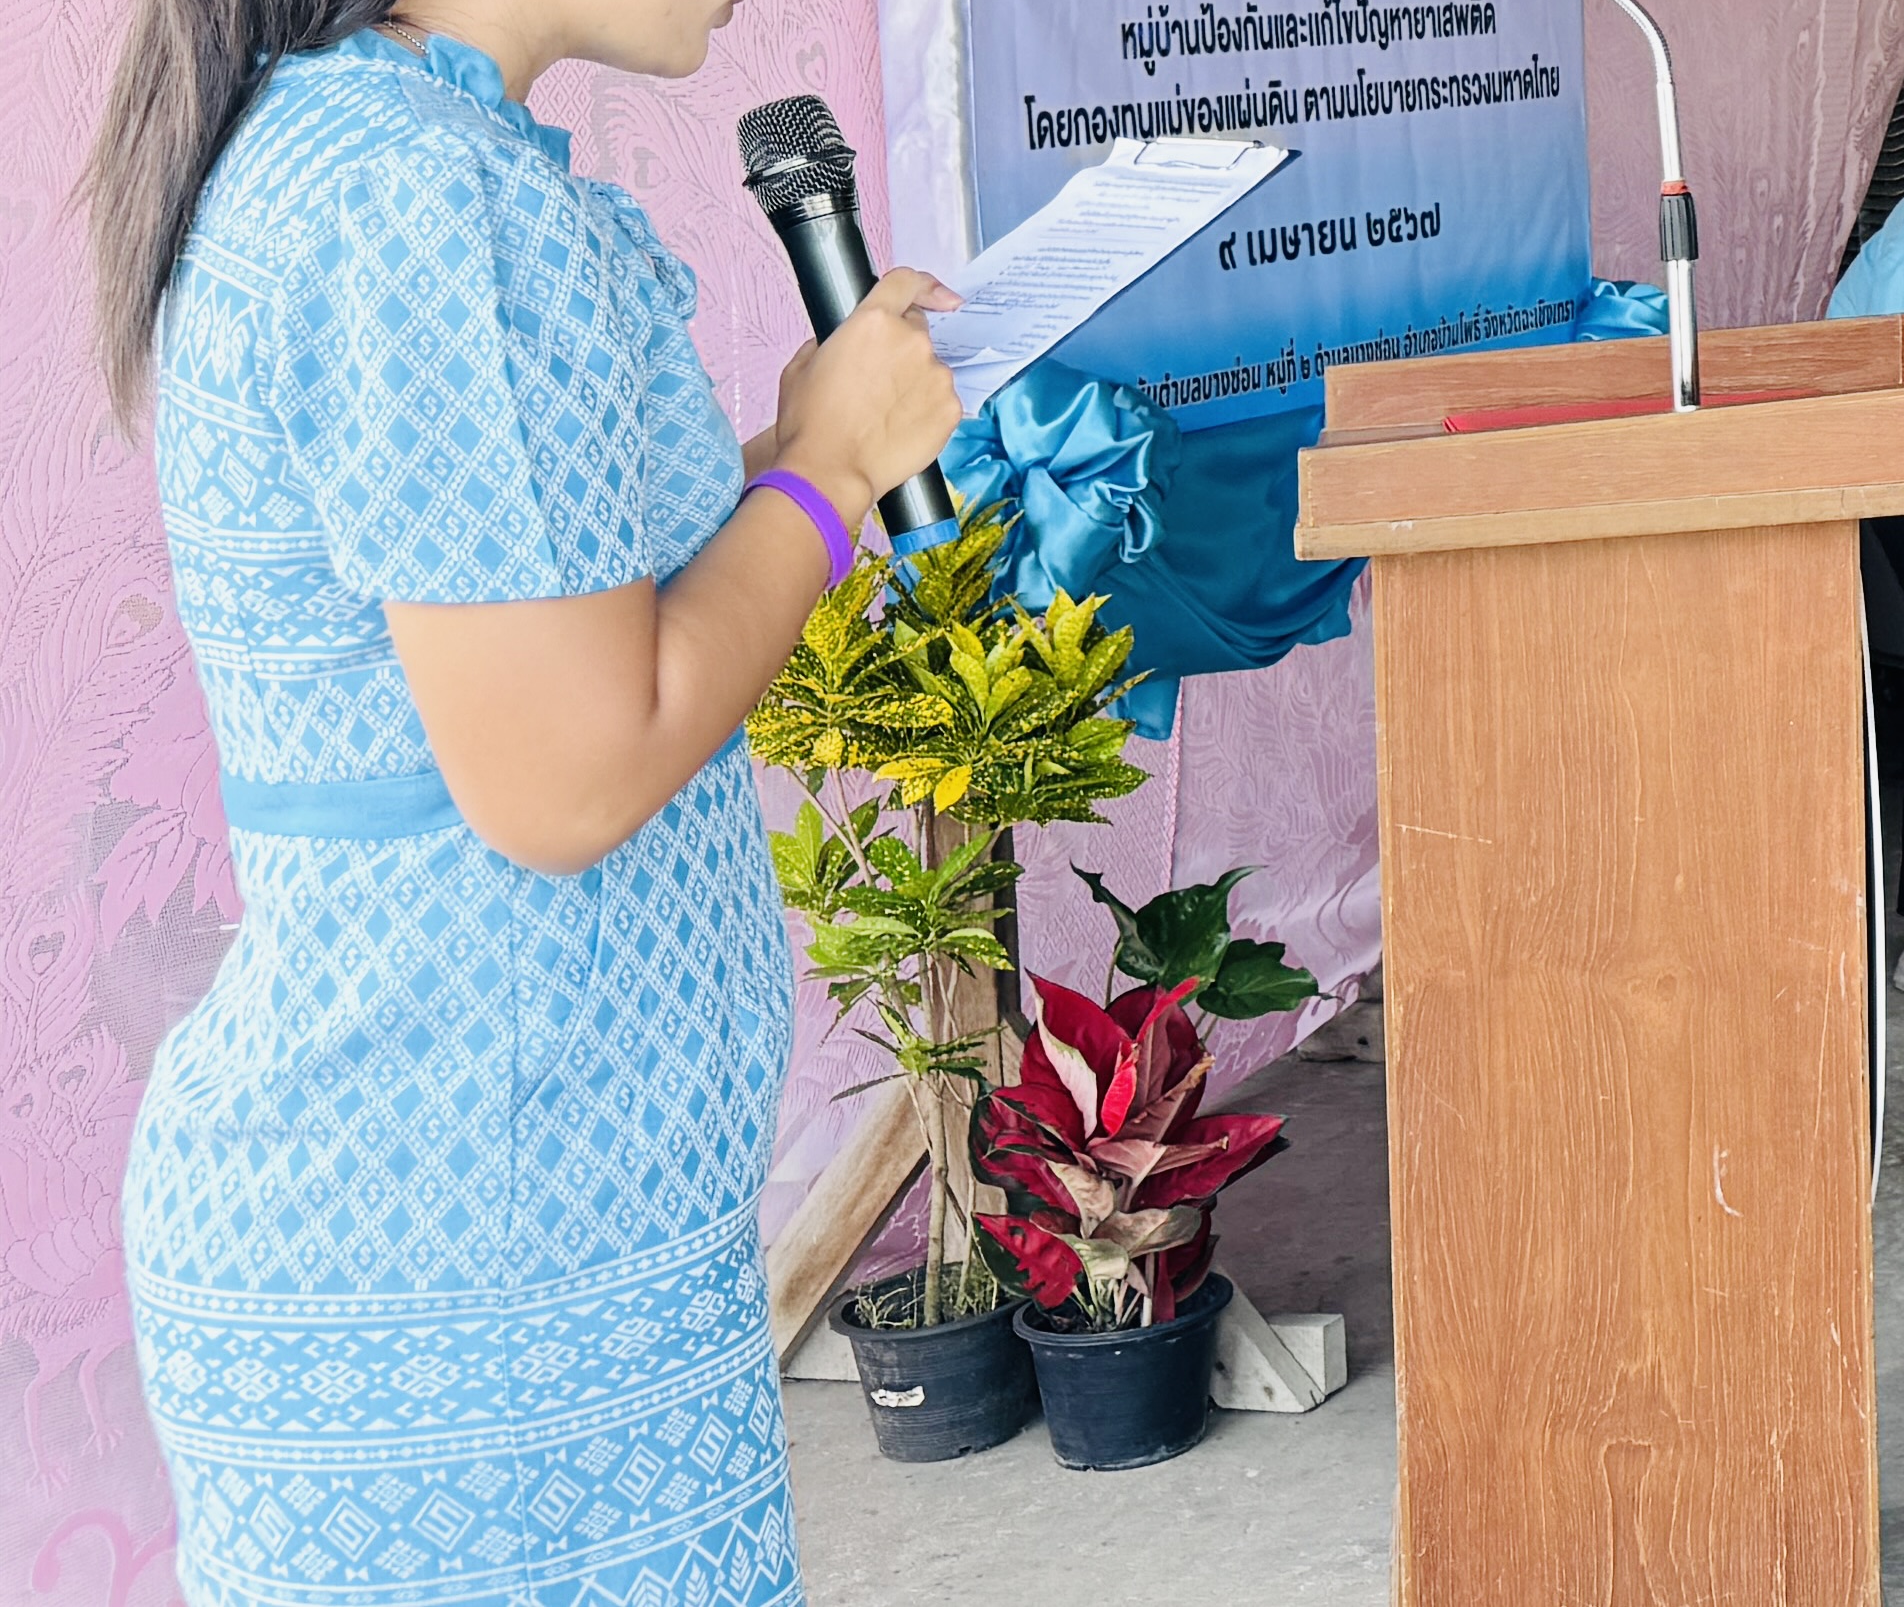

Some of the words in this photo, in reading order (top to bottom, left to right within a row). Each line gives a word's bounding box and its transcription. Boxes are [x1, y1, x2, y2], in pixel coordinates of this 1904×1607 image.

[1303, 53, 1561, 124] ตามนโยบายกระทรวงมหาดไทย
[1246, 220, 1358, 268] เมษายน
[1366, 202, 1442, 247] ๒๕๖๗
